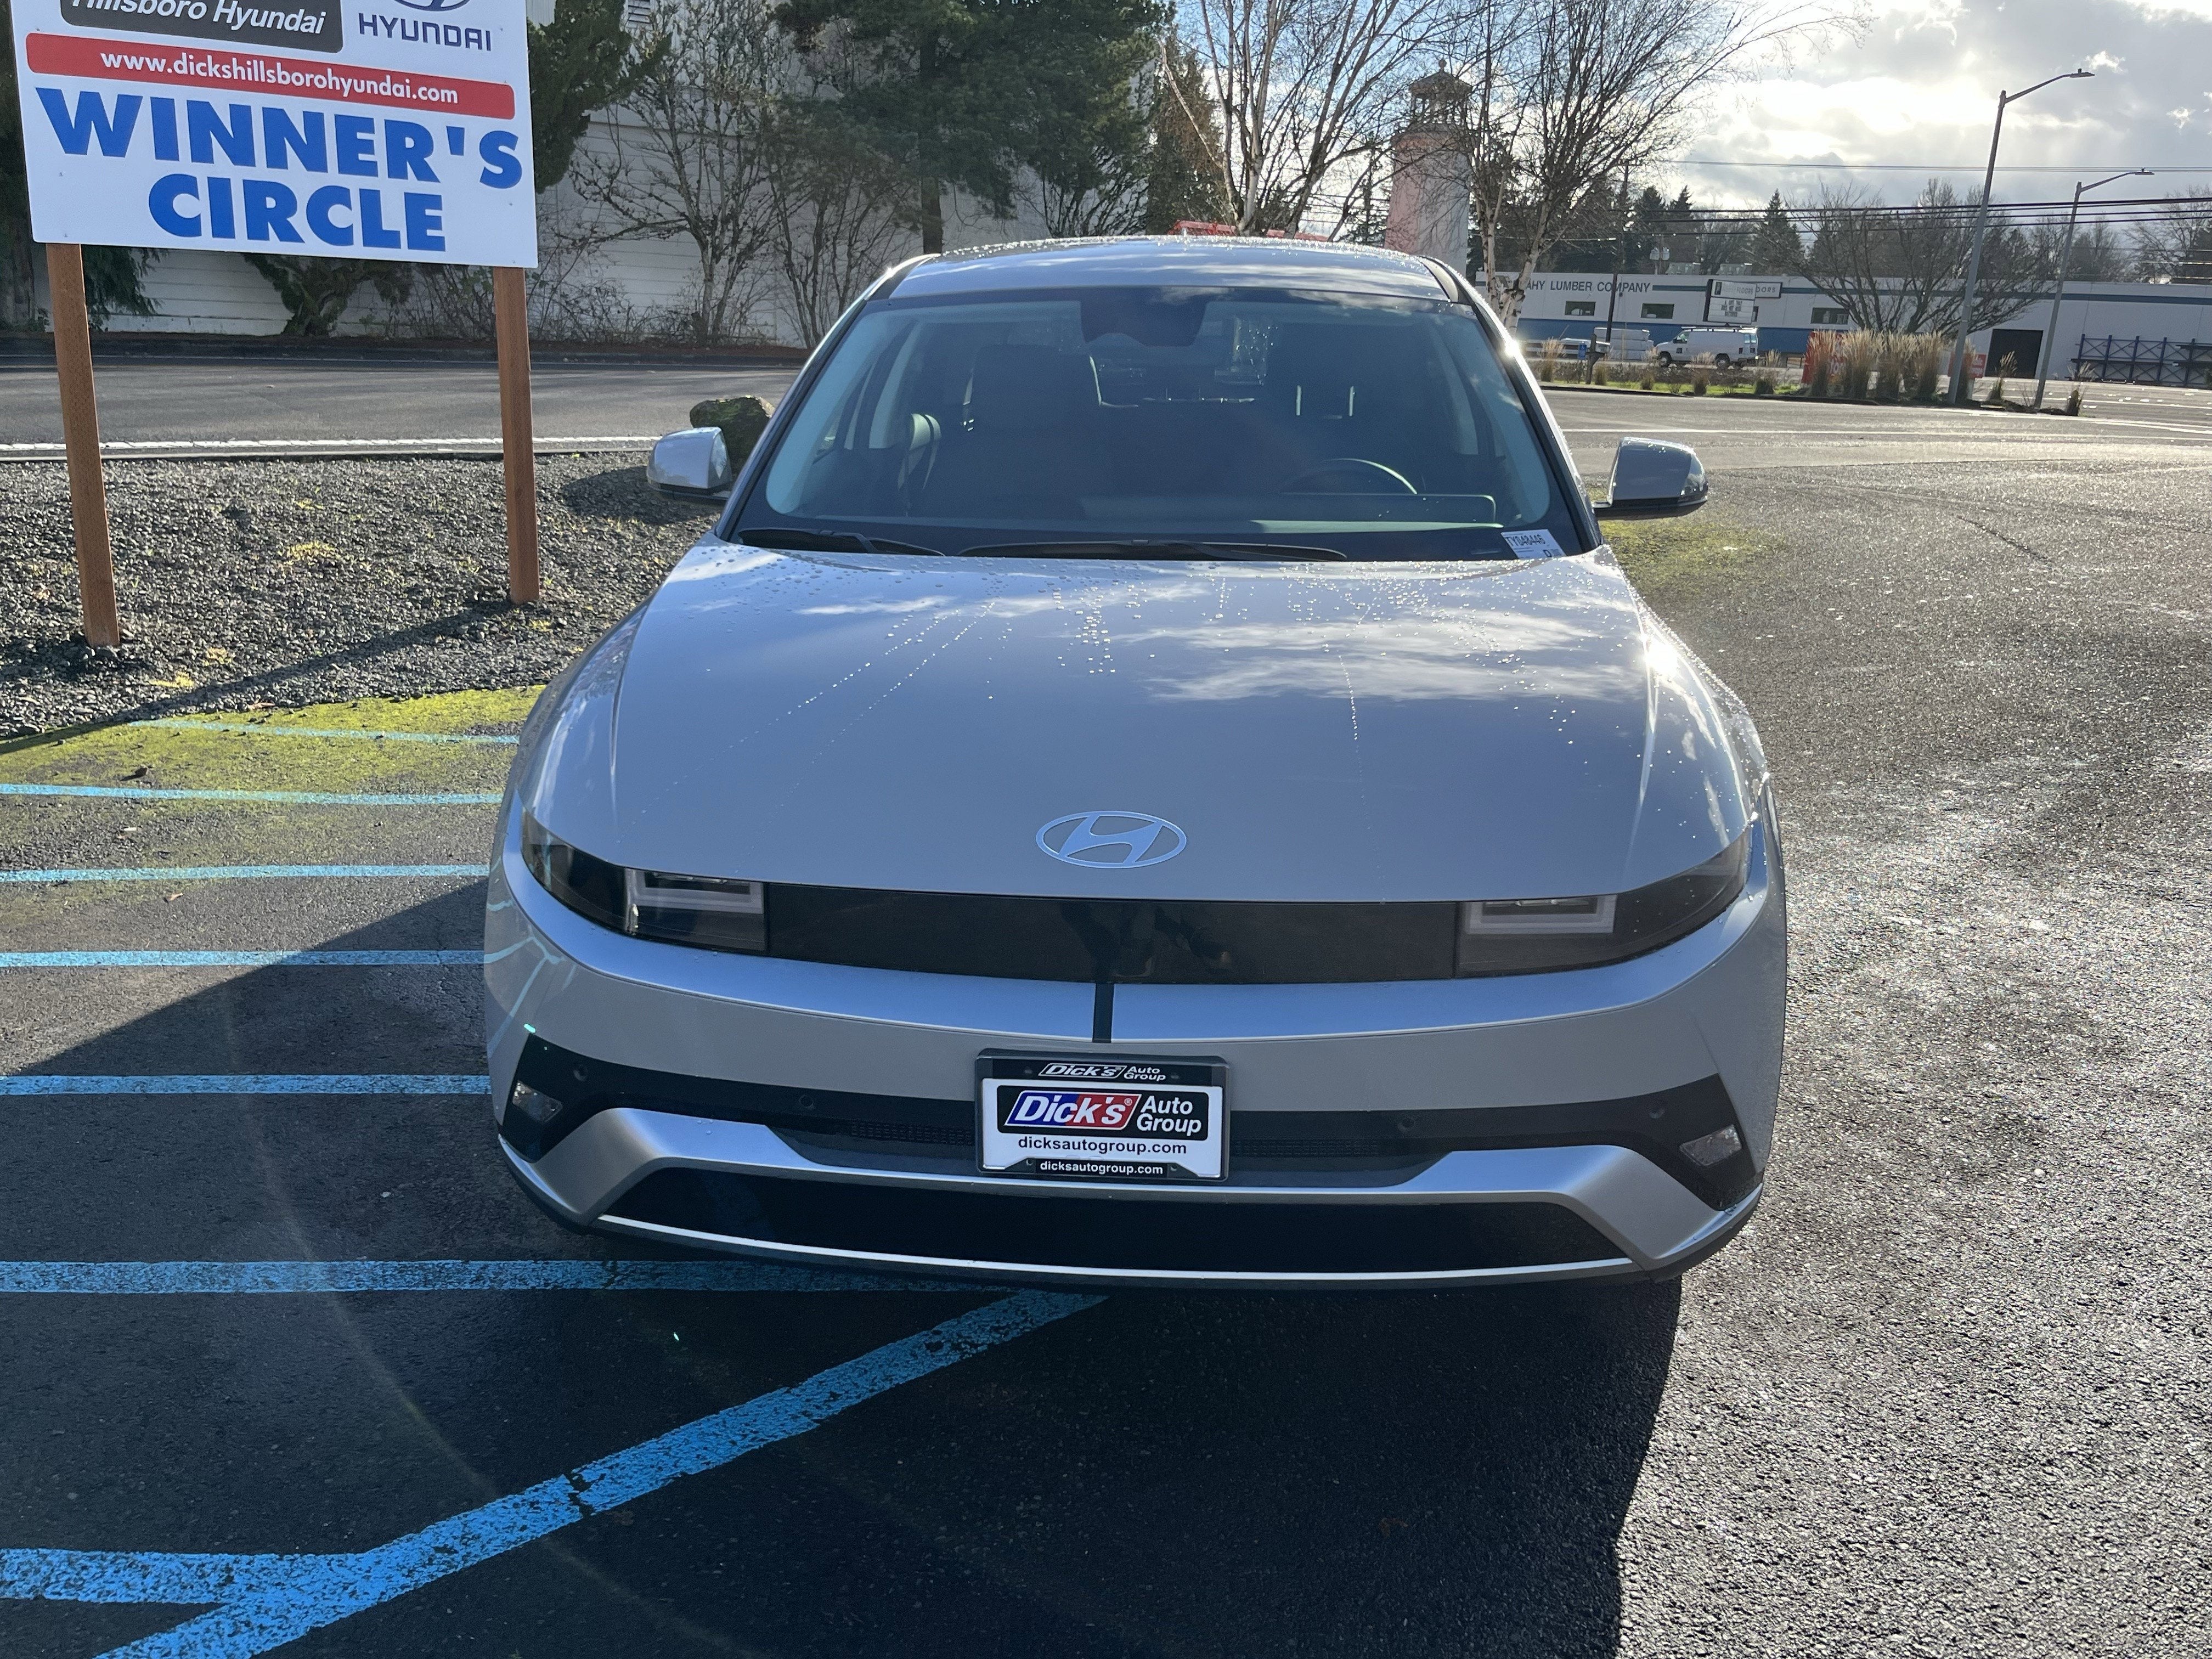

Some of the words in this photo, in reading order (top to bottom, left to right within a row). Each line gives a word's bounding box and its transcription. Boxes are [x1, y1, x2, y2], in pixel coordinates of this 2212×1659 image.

[212, 0, 326, 34] Hyundai
[359, 12, 492, 52] HYUNDAI
[100, 49, 459, 105] www.dickshillsborohyundai.com
[36, 87, 523, 189] WINNER'S
[148, 173, 446, 252] CIRCLE
[1550, 281, 1593, 291] LUMBER
[1597, 281, 1650, 293] COMPANY
[1045, 1065, 1117, 1077] Dick's
[1126, 1066, 1160, 1074] Auto
[1124, 1072, 1166, 1082] Group
[1014, 1094, 1124, 1125] Dick's
[1140, 1095, 1193, 1115] Auto
[1136, 1115, 1202, 1137] Group
[1018, 1136, 1187, 1154] dicksautogroup.com
[1040, 1160, 1163, 1175] dicksautogroup.com
